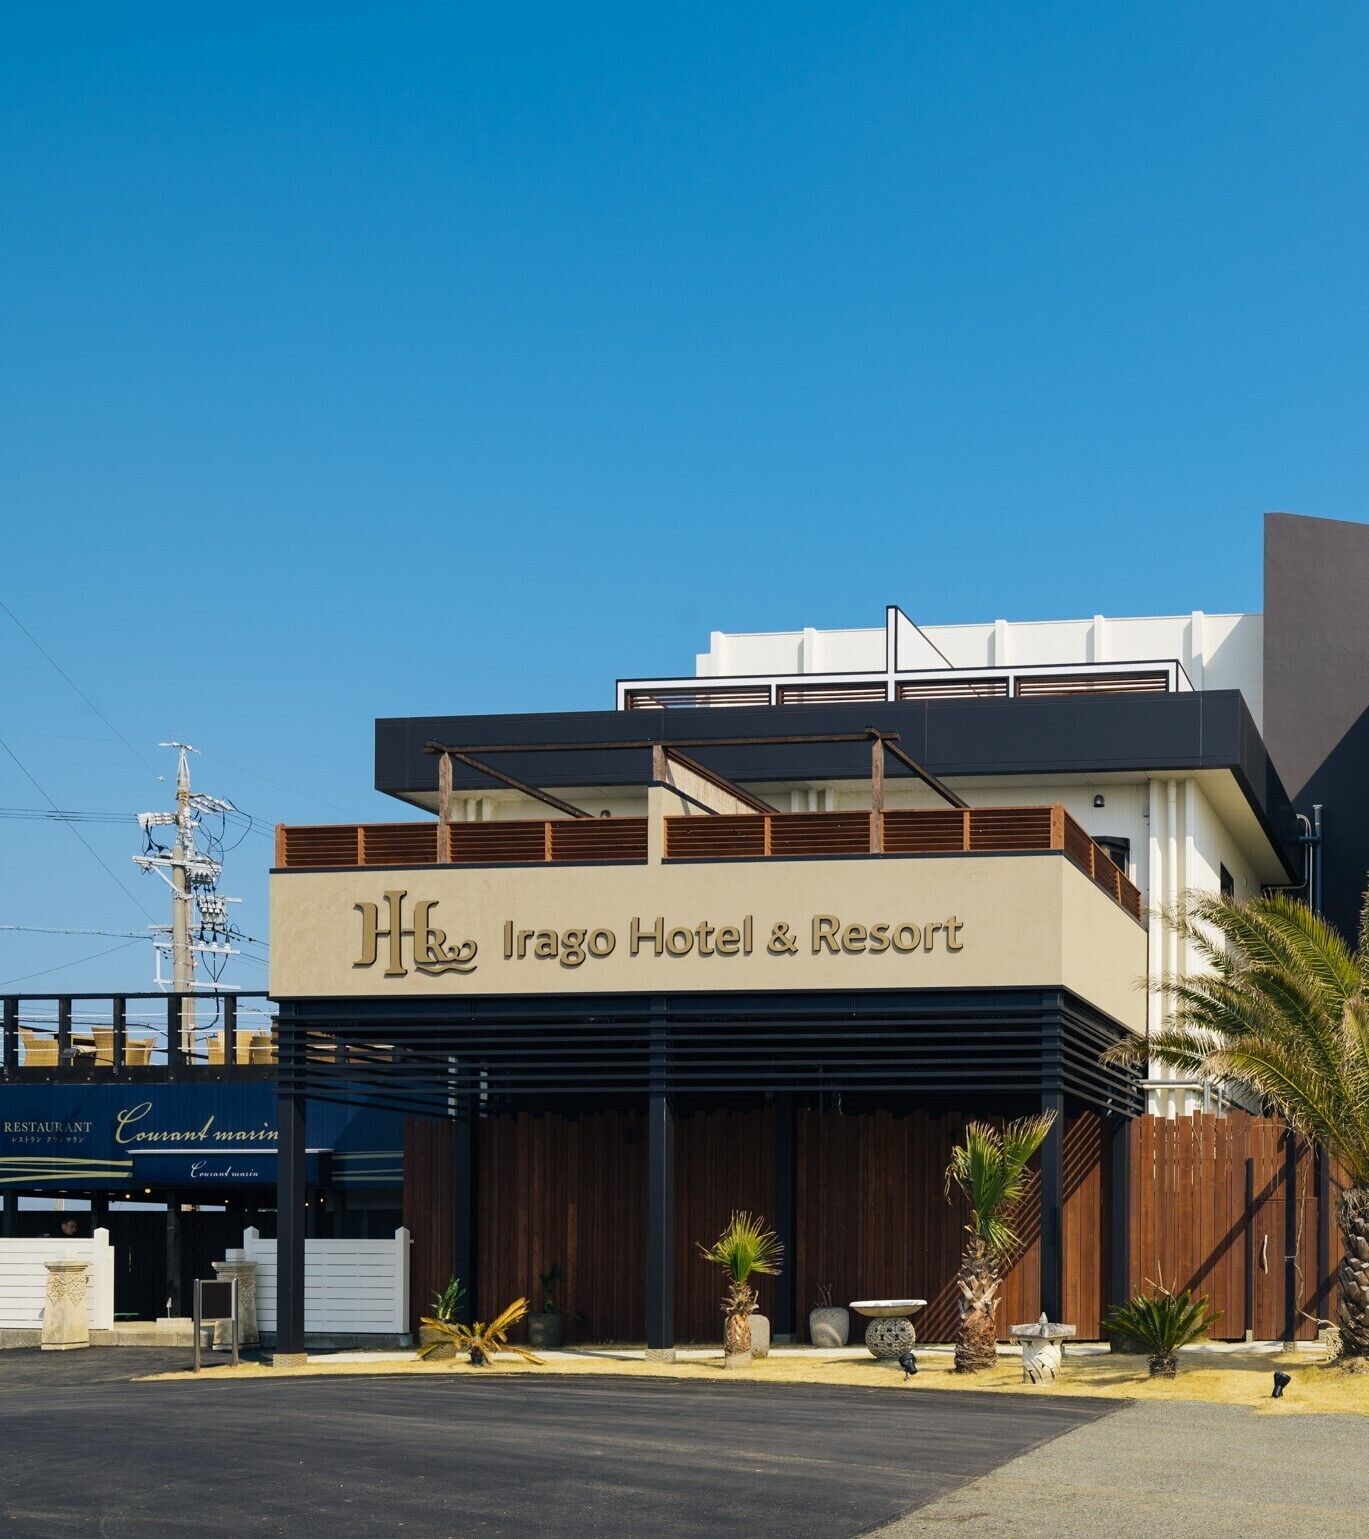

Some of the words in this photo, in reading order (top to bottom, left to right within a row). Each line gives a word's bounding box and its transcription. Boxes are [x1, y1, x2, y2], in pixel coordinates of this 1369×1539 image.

[502, 919, 617, 969] Irago
[630, 913, 754, 959] Hotel
[766, 919, 799, 956] &
[811, 912, 964, 955] Resort
[4, 1121, 93, 1133] RESTAURANT
[115, 1101, 215, 1144] Courant
[212, 1121, 279, 1141] marin
[11, 1136, 42, 1144] レストラン
[190, 1160, 232, 1178] Courant
[231, 1166, 259, 1177] marin
